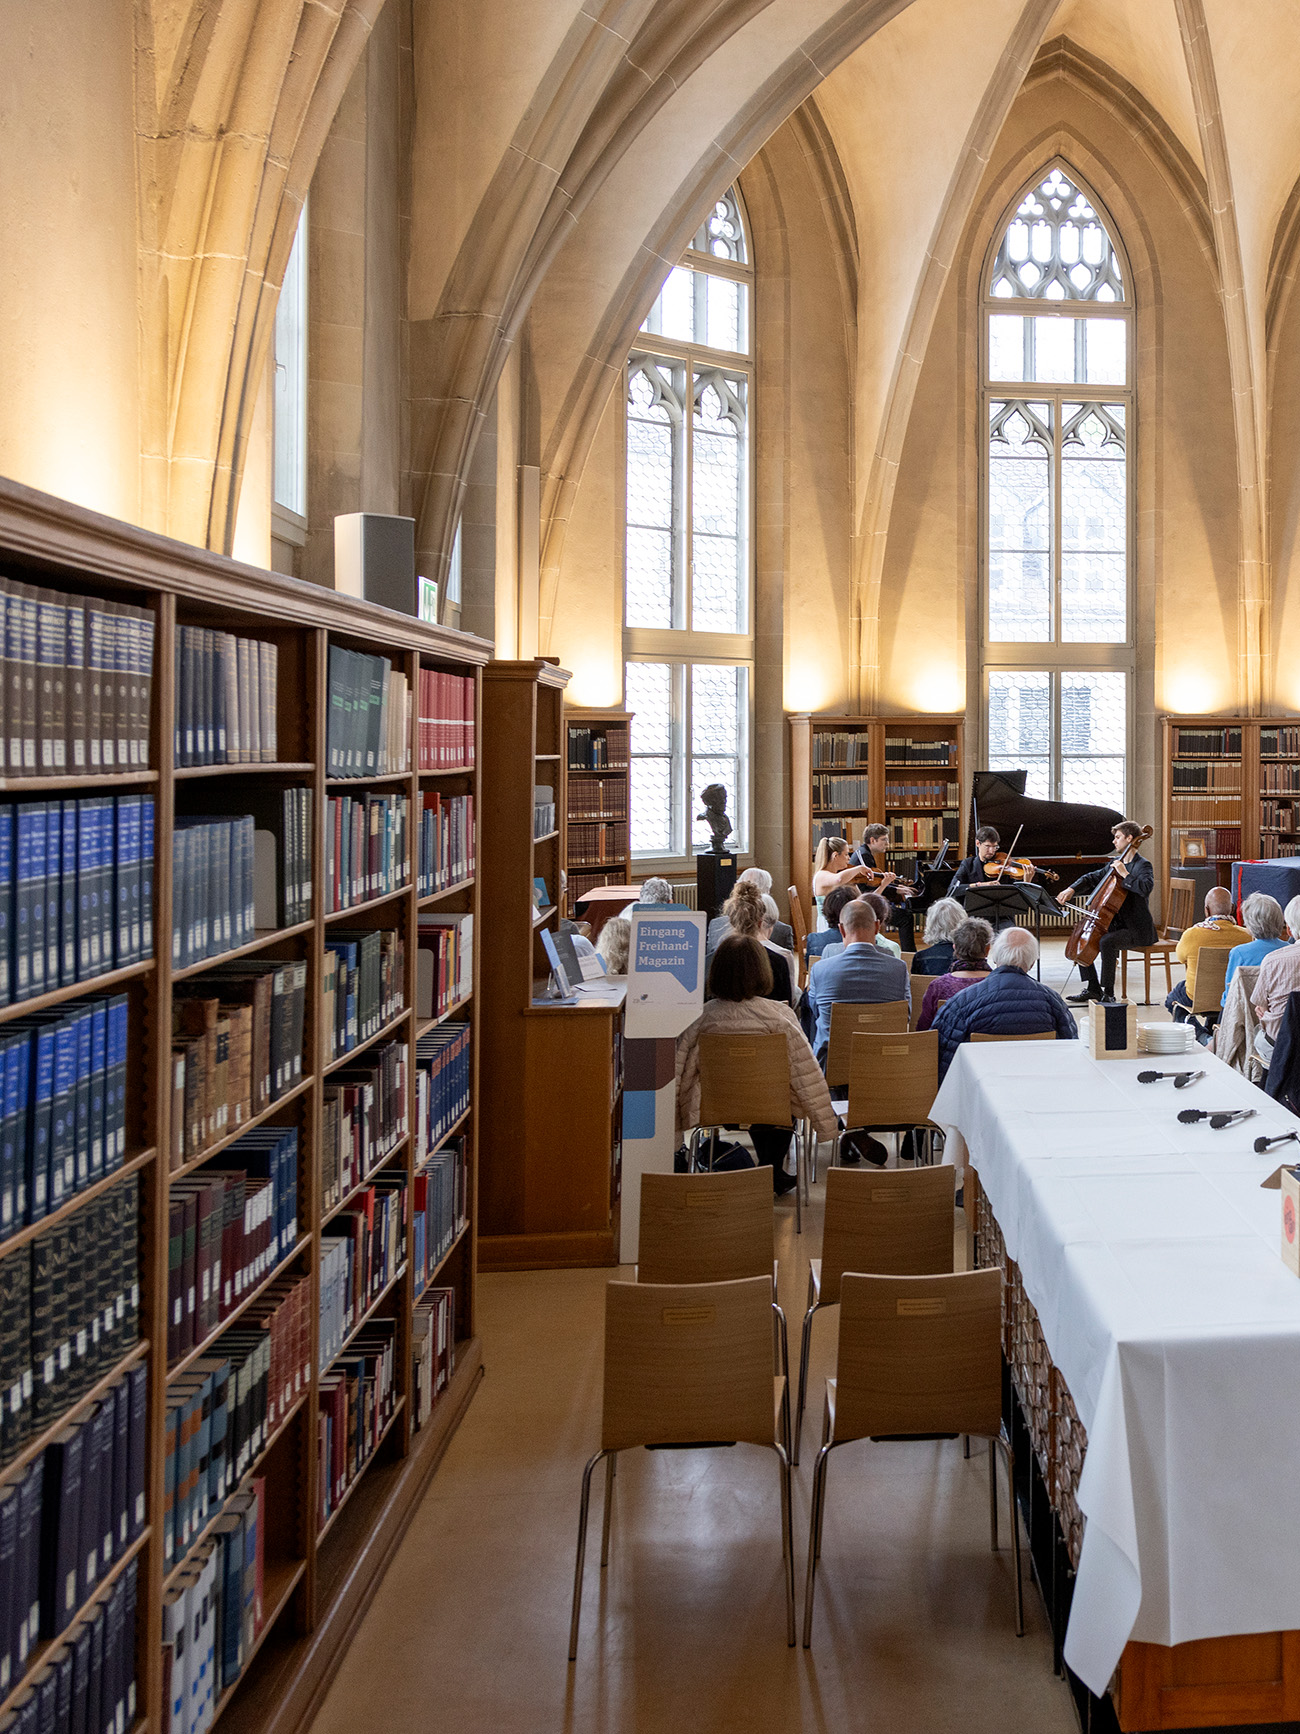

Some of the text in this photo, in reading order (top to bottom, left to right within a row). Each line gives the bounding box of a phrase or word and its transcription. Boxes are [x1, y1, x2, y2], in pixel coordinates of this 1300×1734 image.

[640, 926, 685, 938] Eingang
[639, 941, 693, 951] Freihand-
[638, 955, 685, 967] Magazin
